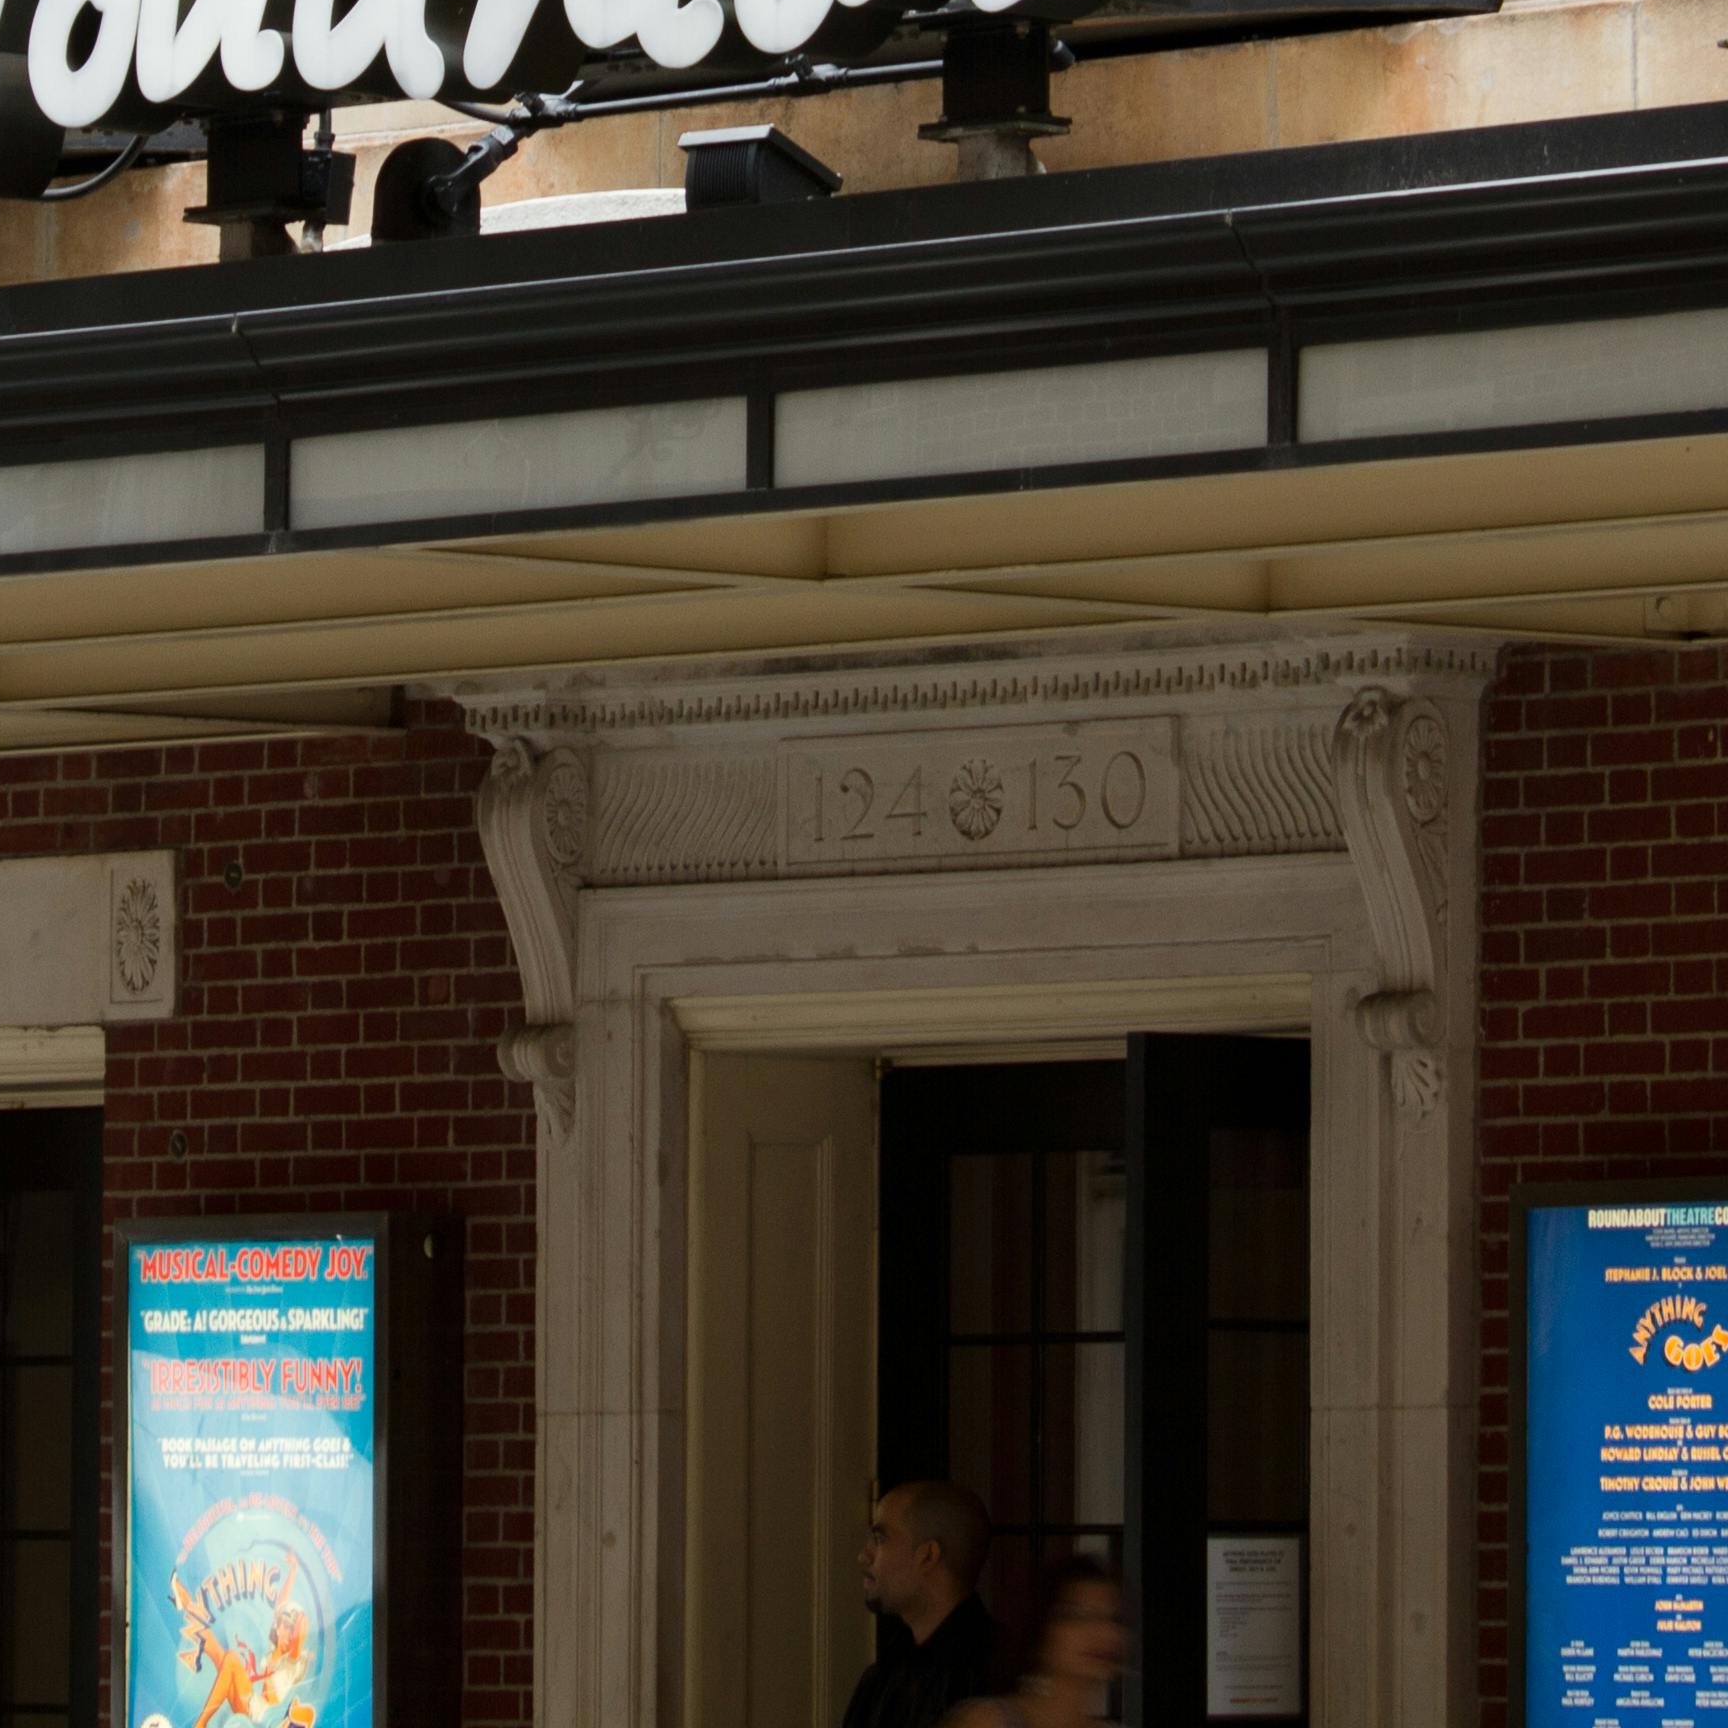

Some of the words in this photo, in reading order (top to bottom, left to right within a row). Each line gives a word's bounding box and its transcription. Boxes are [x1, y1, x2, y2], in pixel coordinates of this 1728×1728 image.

[812, 763, 928, 843] 124
[1025, 749, 1148, 831] 130
[1661, 1265, 1695, 1282] BLOCK
[1704, 1265, 1728, 1281] JOEL
[208, 1307, 280, 1333] GORGEOUS
[1629, 1294, 1709, 1366] ANYTHING
[281, 1357, 364, 1394] FUNNY!
[1675, 1393, 1713, 1410] PORTER
[176, 1558, 283, 1673] ANYTHING
